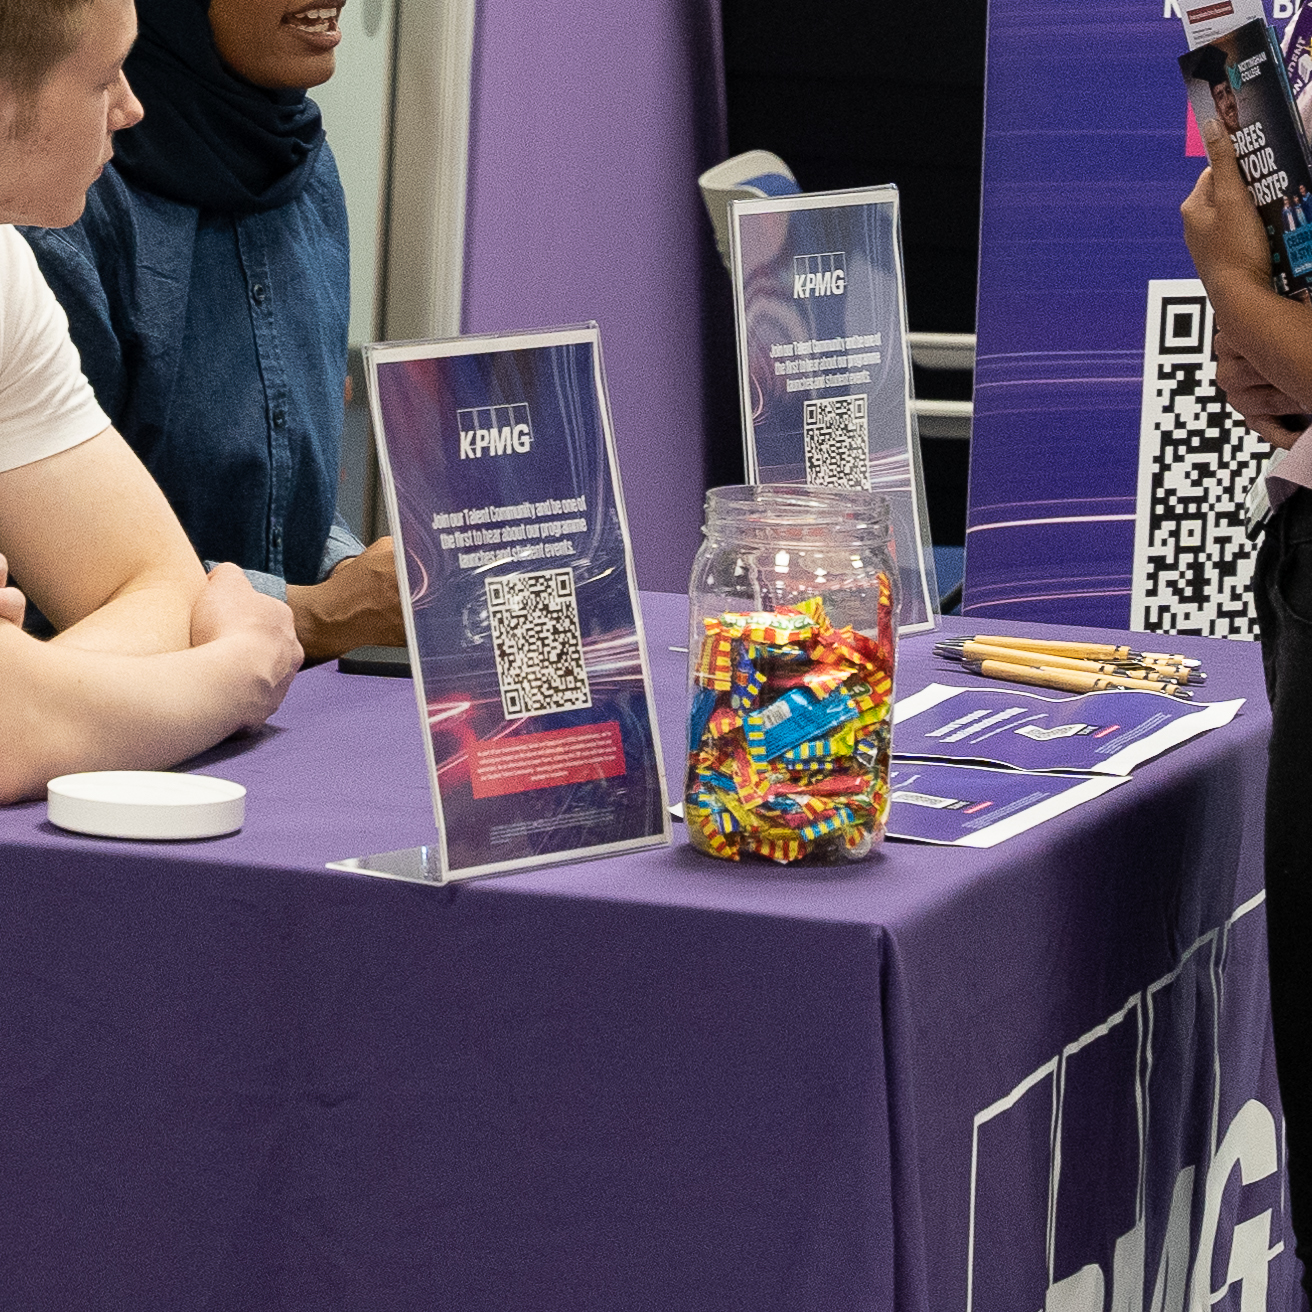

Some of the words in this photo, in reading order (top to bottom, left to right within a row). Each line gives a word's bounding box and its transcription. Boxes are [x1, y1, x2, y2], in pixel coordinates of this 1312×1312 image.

[1237, 51, 1267, 73] NOTTINGHAM
[1288, 36, 1306, 79] DENT
[1240, 147, 1277, 181] YOUR
[793, 269, 845, 300] KPMG
[460, 423, 532, 460] KPMG
[432, 512, 449, 529] Join
[450, 512, 464, 527] our
[463, 507, 490, 525] Talent
[490, 502, 536, 522] Community
[536, 499, 551, 516] and
[440, 533, 455, 550] the
[455, 531, 473, 547] first
[501, 523, 525, 541] about
[526, 524, 540, 538] our
[540, 518, 588, 539] programme
